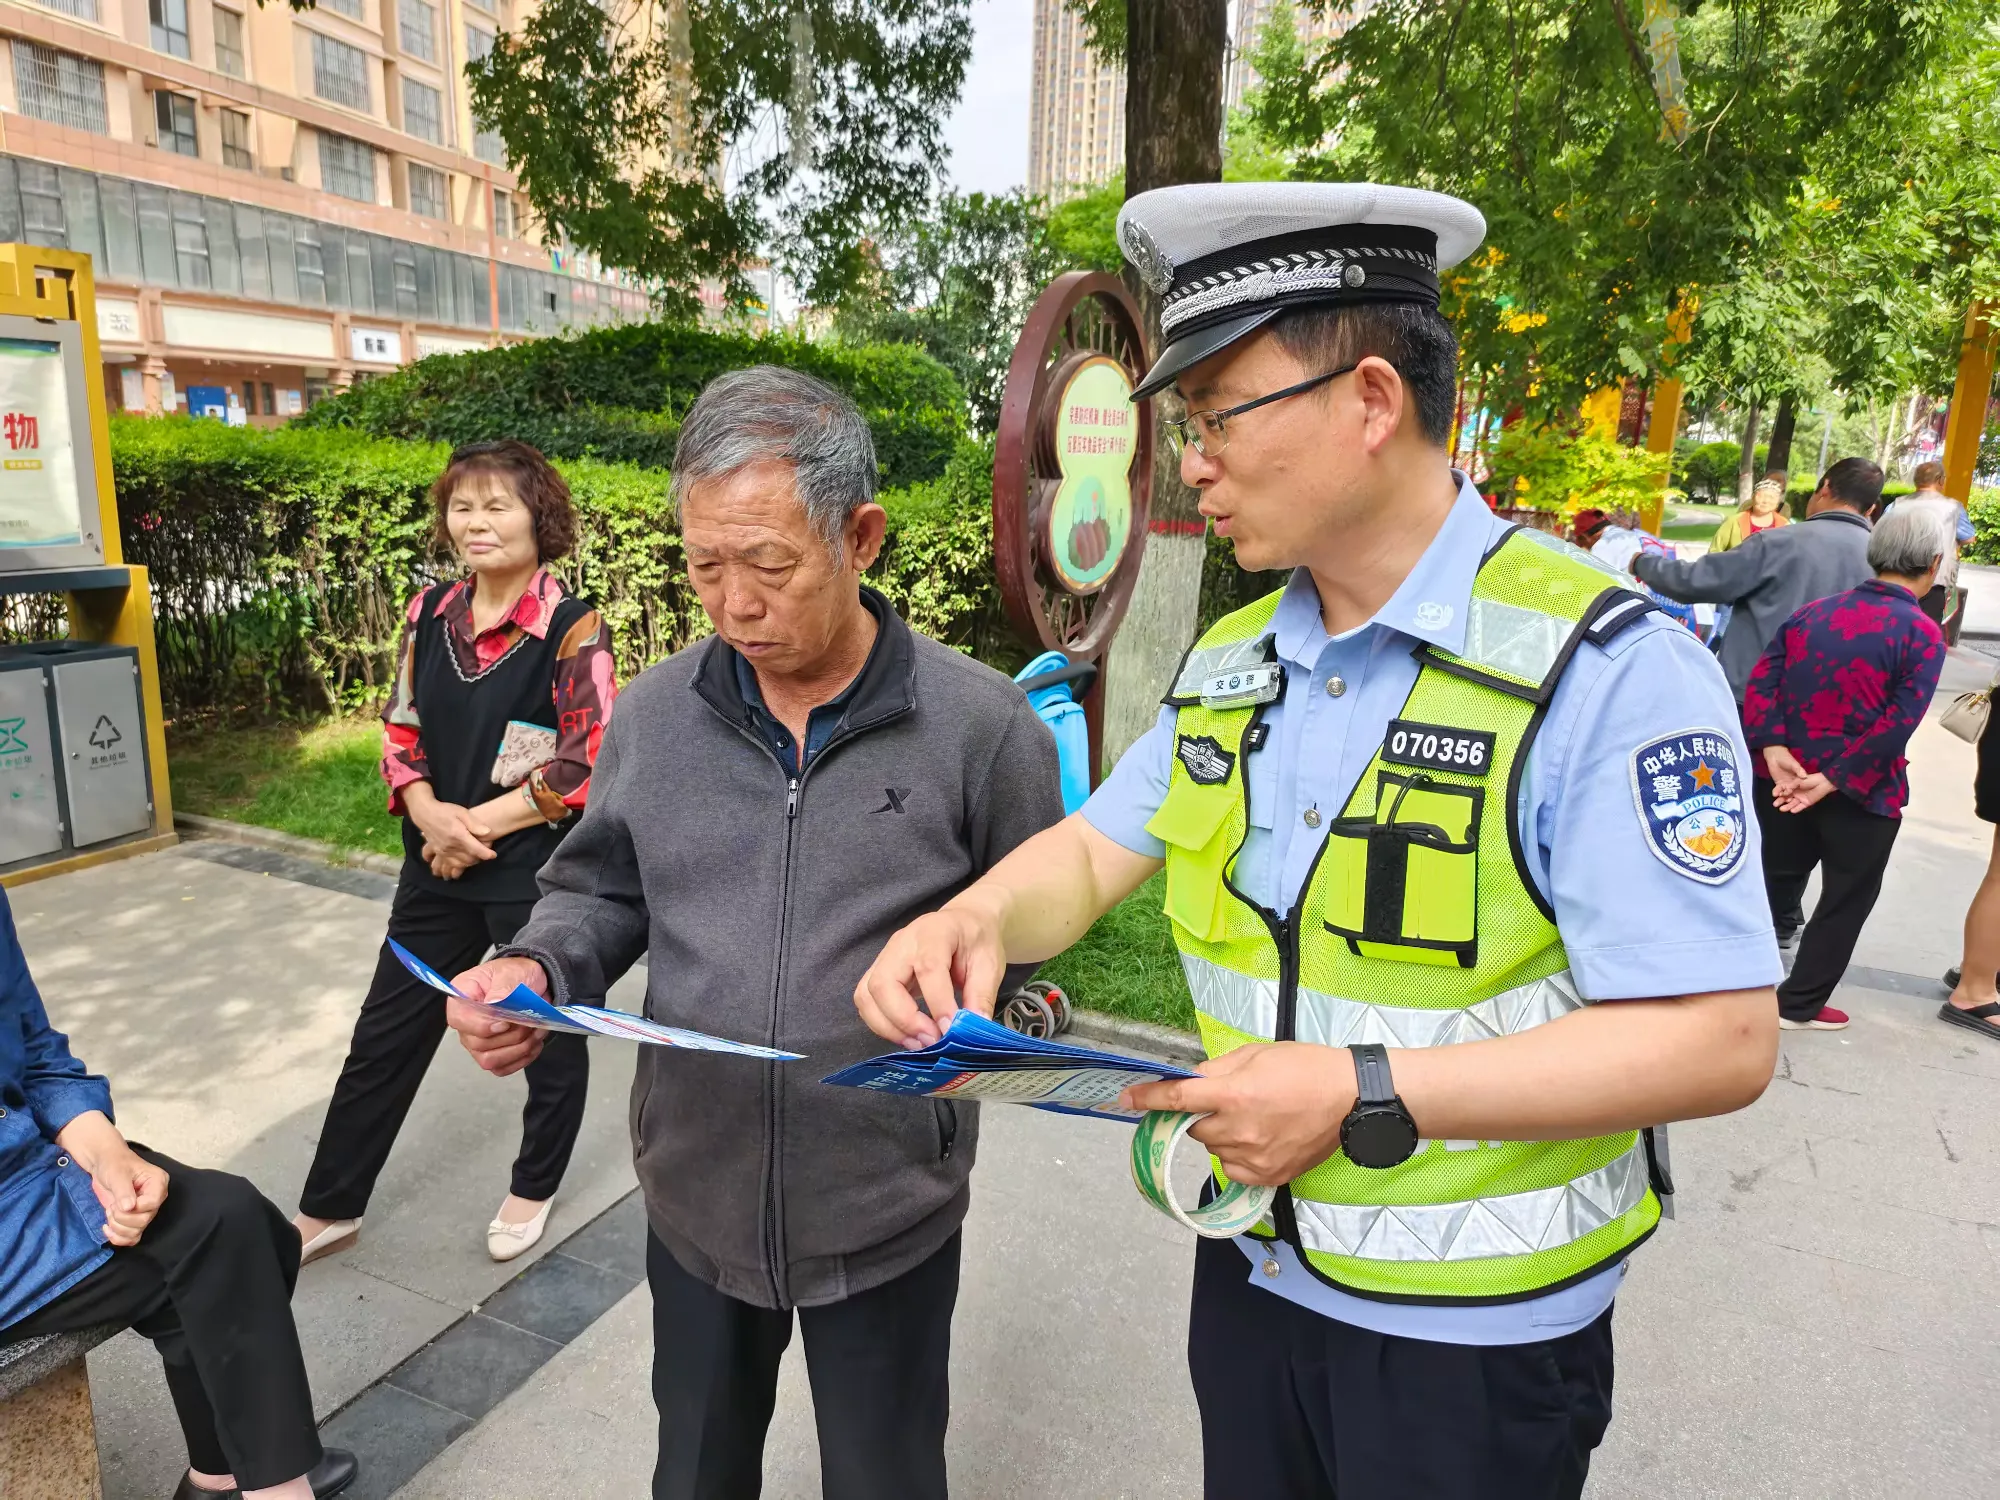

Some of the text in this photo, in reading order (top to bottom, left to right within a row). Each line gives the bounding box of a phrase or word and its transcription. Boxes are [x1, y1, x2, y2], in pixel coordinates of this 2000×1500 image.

[3, 412, 40, 451] 物
[1215, 679, 1225, 691] 交
[1391, 731, 1486, 766] 070356
[1642, 737, 1735, 776] 中华人民共和国
[1652, 768, 1736, 802] 警 察
[1681, 797, 1726, 814] POLICE
[1688, 814, 1726, 830] 公 安
